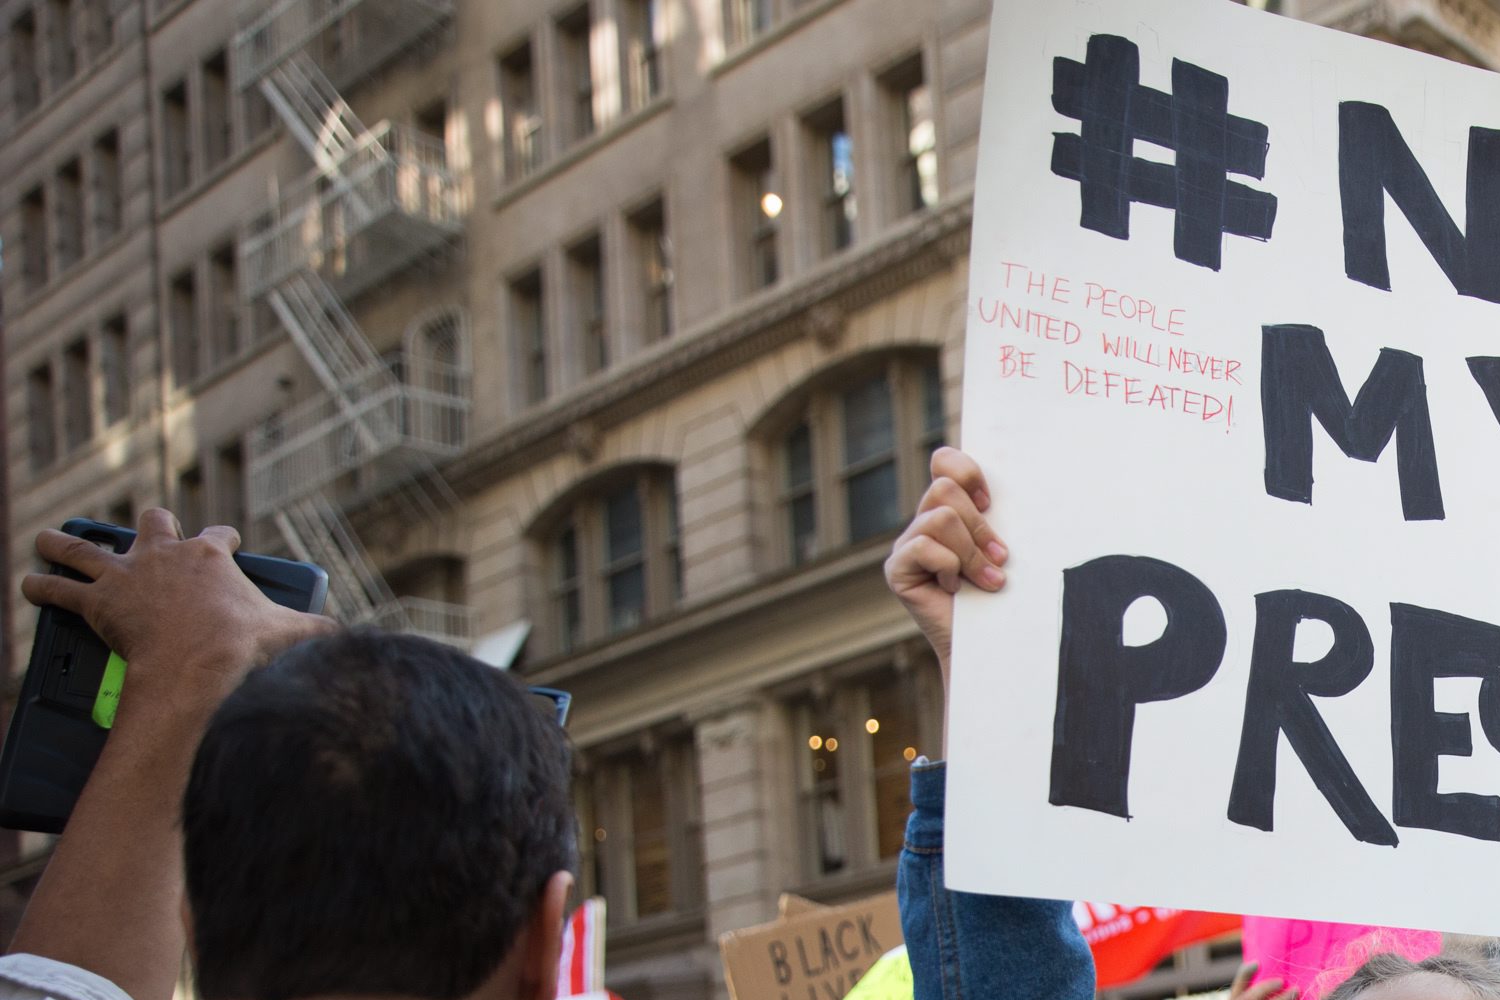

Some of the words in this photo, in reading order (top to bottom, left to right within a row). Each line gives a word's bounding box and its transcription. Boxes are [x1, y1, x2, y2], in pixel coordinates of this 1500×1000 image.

[1001, 262, 1070, 303] THE
[1085, 283, 1186, 336] PEOPLE
[979, 297, 1081, 345] UNITED
[1102, 333, 1160, 367] WILL
[1169, 347, 1242, 386] NEVER
[1000, 345, 1038, 379] BE
[1064, 360, 1233, 434] DEFEATED!
[768, 913, 883, 986] BLACK
